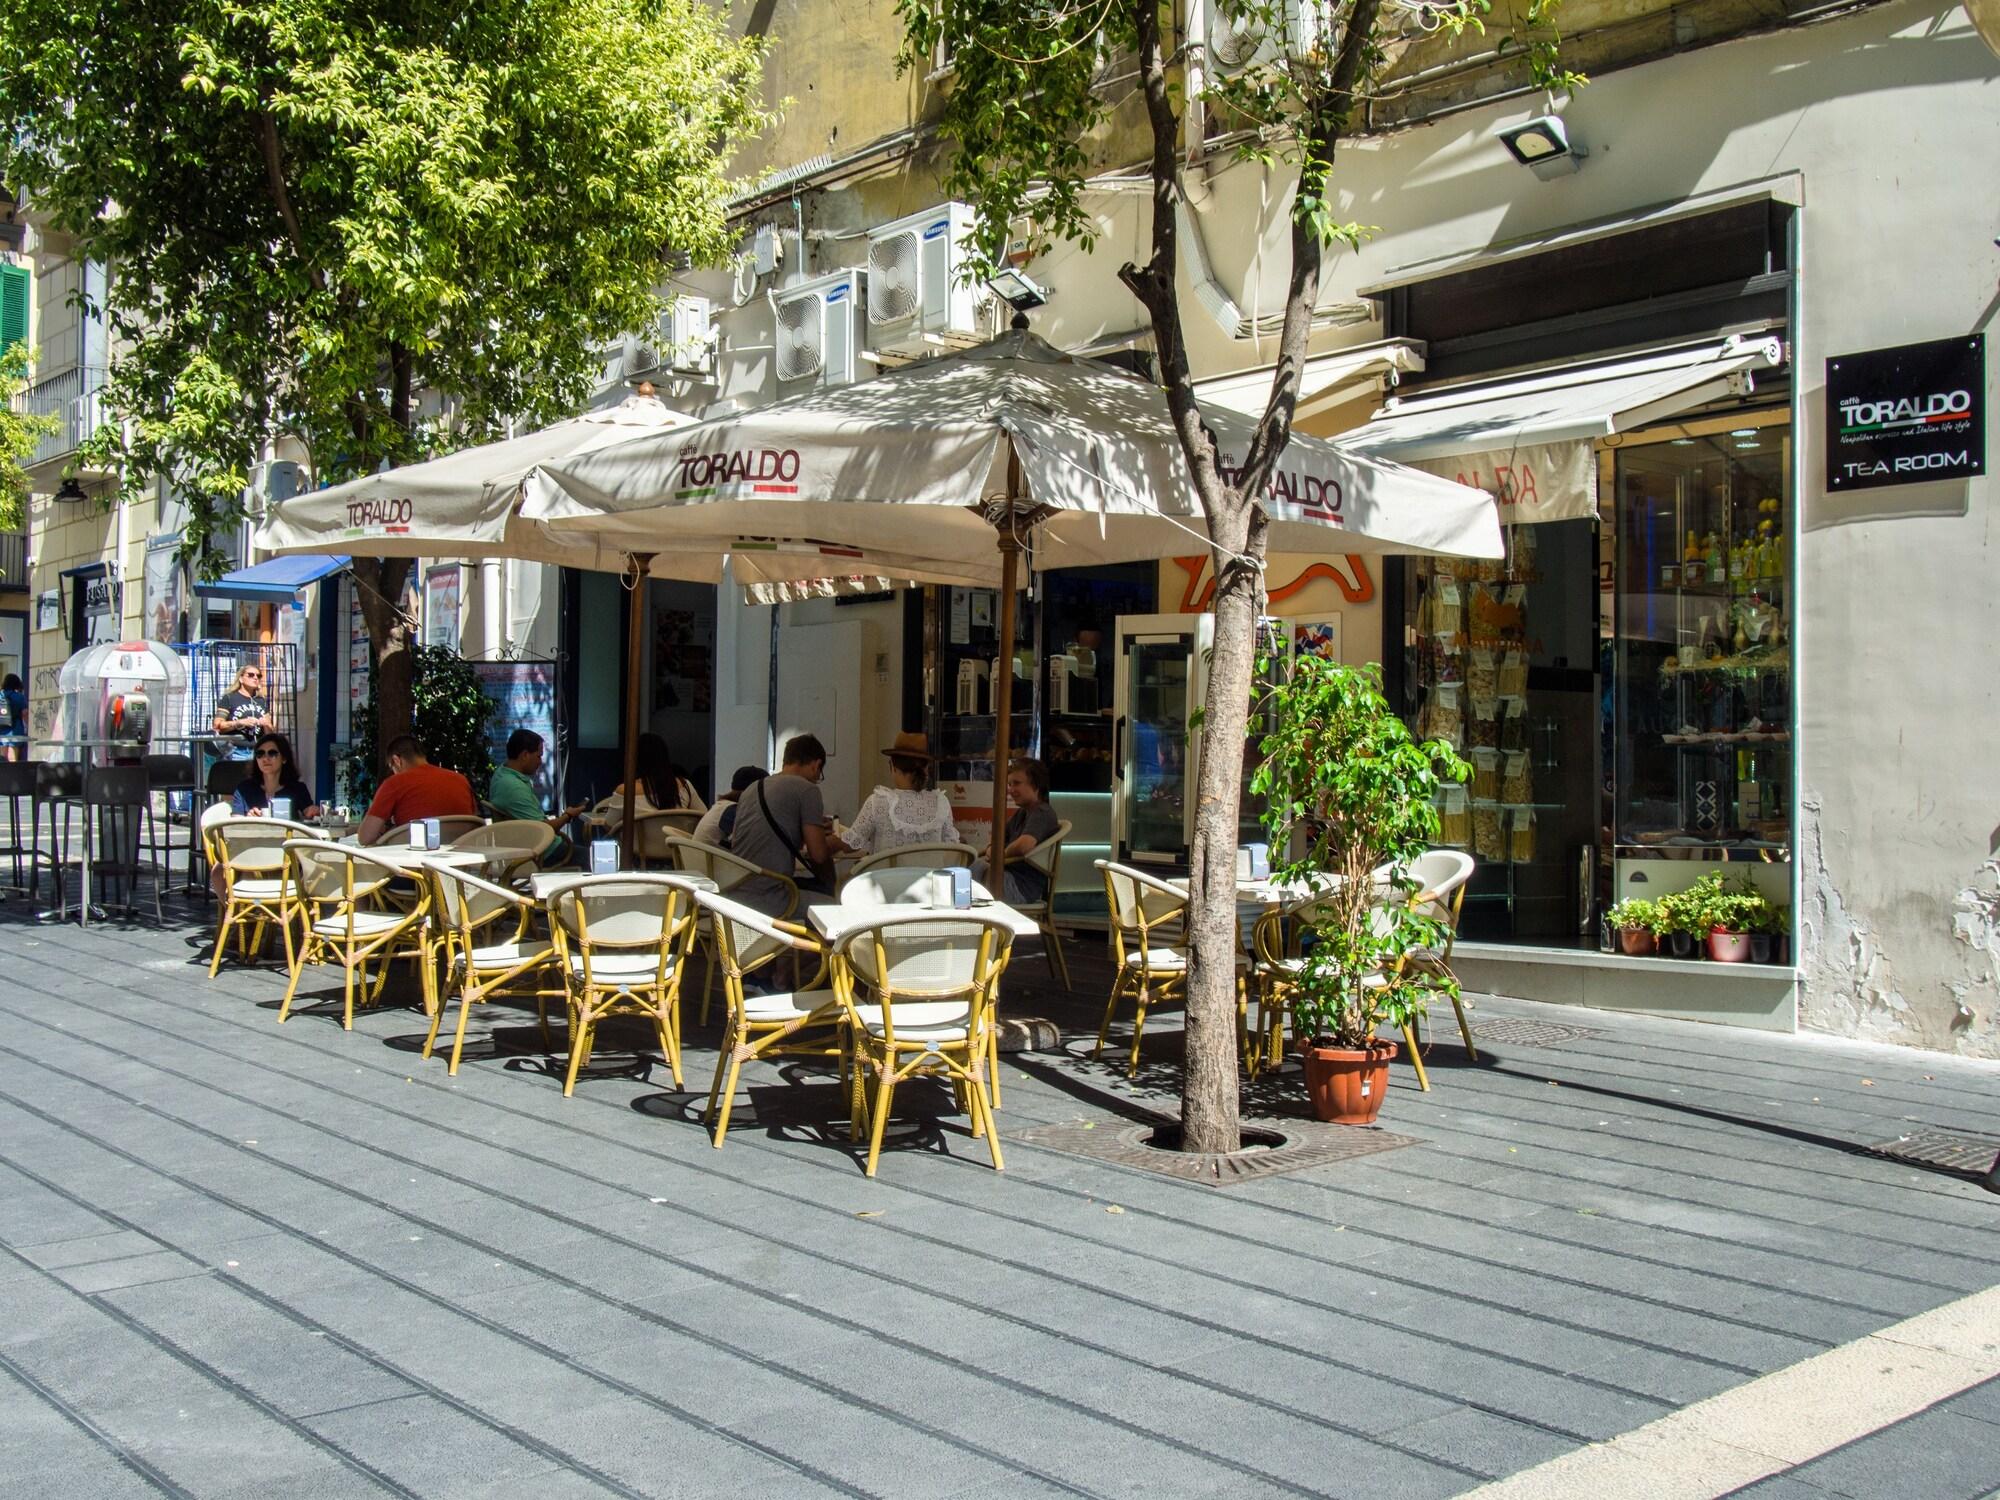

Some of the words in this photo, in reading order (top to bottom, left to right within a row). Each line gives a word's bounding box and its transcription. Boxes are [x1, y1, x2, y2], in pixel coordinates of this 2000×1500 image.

[1840, 396, 1860, 406] caffè
[1840, 390, 1971, 427] TORALDO
[1916, 424, 1940, 434] Italian
[680, 445, 698, 456] caffè
[1843, 460, 1890, 478] TEA
[1895, 450, 1968, 473] ROOM
[680, 449, 800, 488] TORALDO
[347, 498, 412, 528] TORALDO
